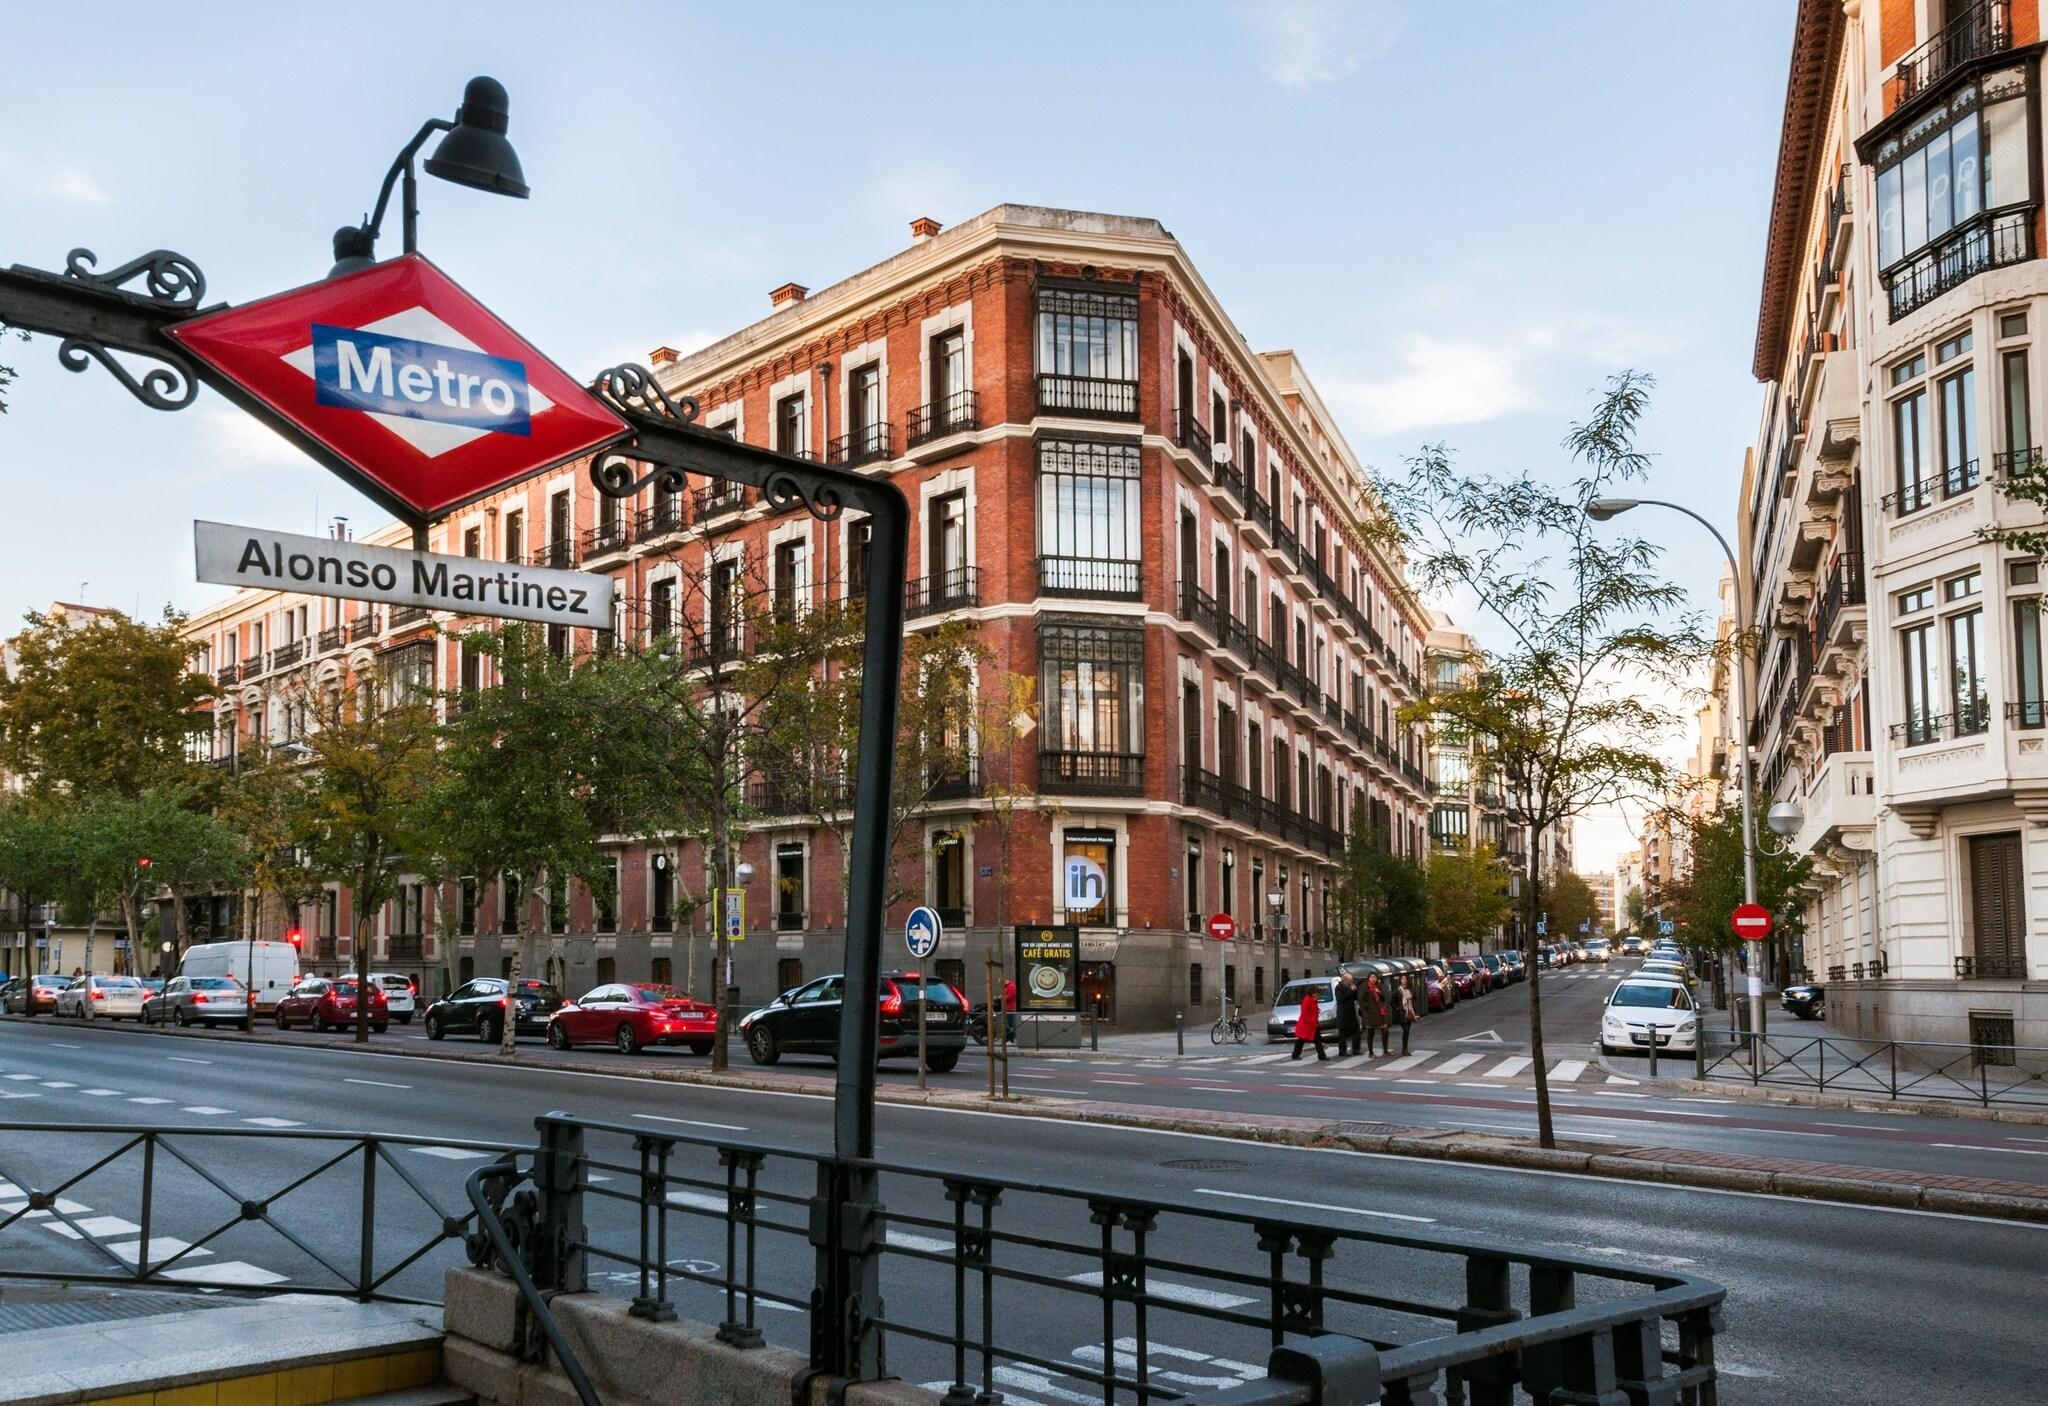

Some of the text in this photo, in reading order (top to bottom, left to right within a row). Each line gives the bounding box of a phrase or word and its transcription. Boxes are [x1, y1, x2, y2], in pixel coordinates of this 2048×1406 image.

[336, 339, 515, 416] Metro
[237, 538, 589, 615] Alonso Martínez
[1071, 865, 1102, 898] ih
[1023, 947, 1071, 958] CAFÉ GRATIS
